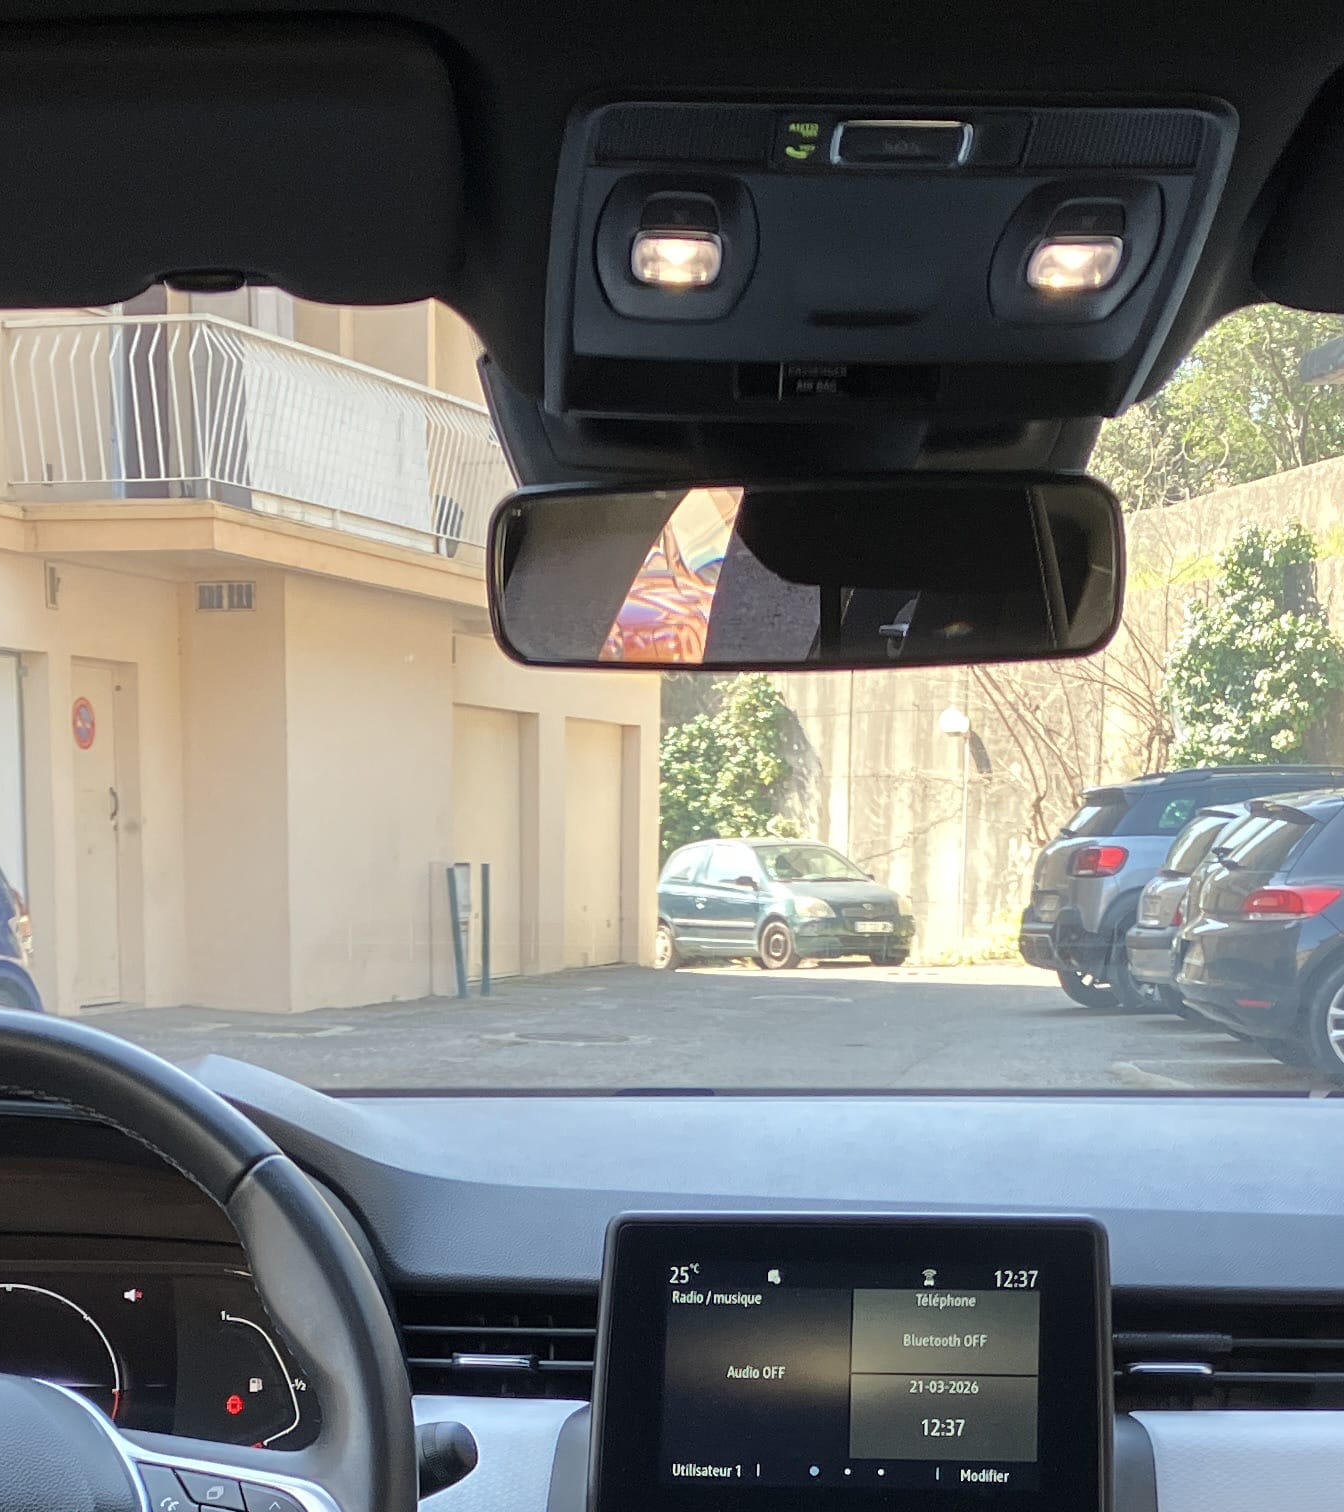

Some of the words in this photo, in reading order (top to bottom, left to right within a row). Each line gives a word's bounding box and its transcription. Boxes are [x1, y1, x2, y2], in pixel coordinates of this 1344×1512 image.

[993, 1270, 1039, 1288] 12:37
[672, 1290, 704, 1304] Radio
[713, 1292, 763, 1307] musique
[915, 1292, 977, 1308] Téléphone
[902, 1333, 961, 1348] Bluetooth
[963, 1334, 988, 1347] OFF
[726, 1365, 760, 1379] Audio
[762, 1366, 786, 1379] OFF
[908, 1381, 980, 1395] 21-03-2026
[920, 1418, 966, 1437] 12:37
[671, 1462, 733, 1478] Utilisateur
[735, 1464, 742, 1477] 1
[959, 1468, 1010, 1484] Modifier
